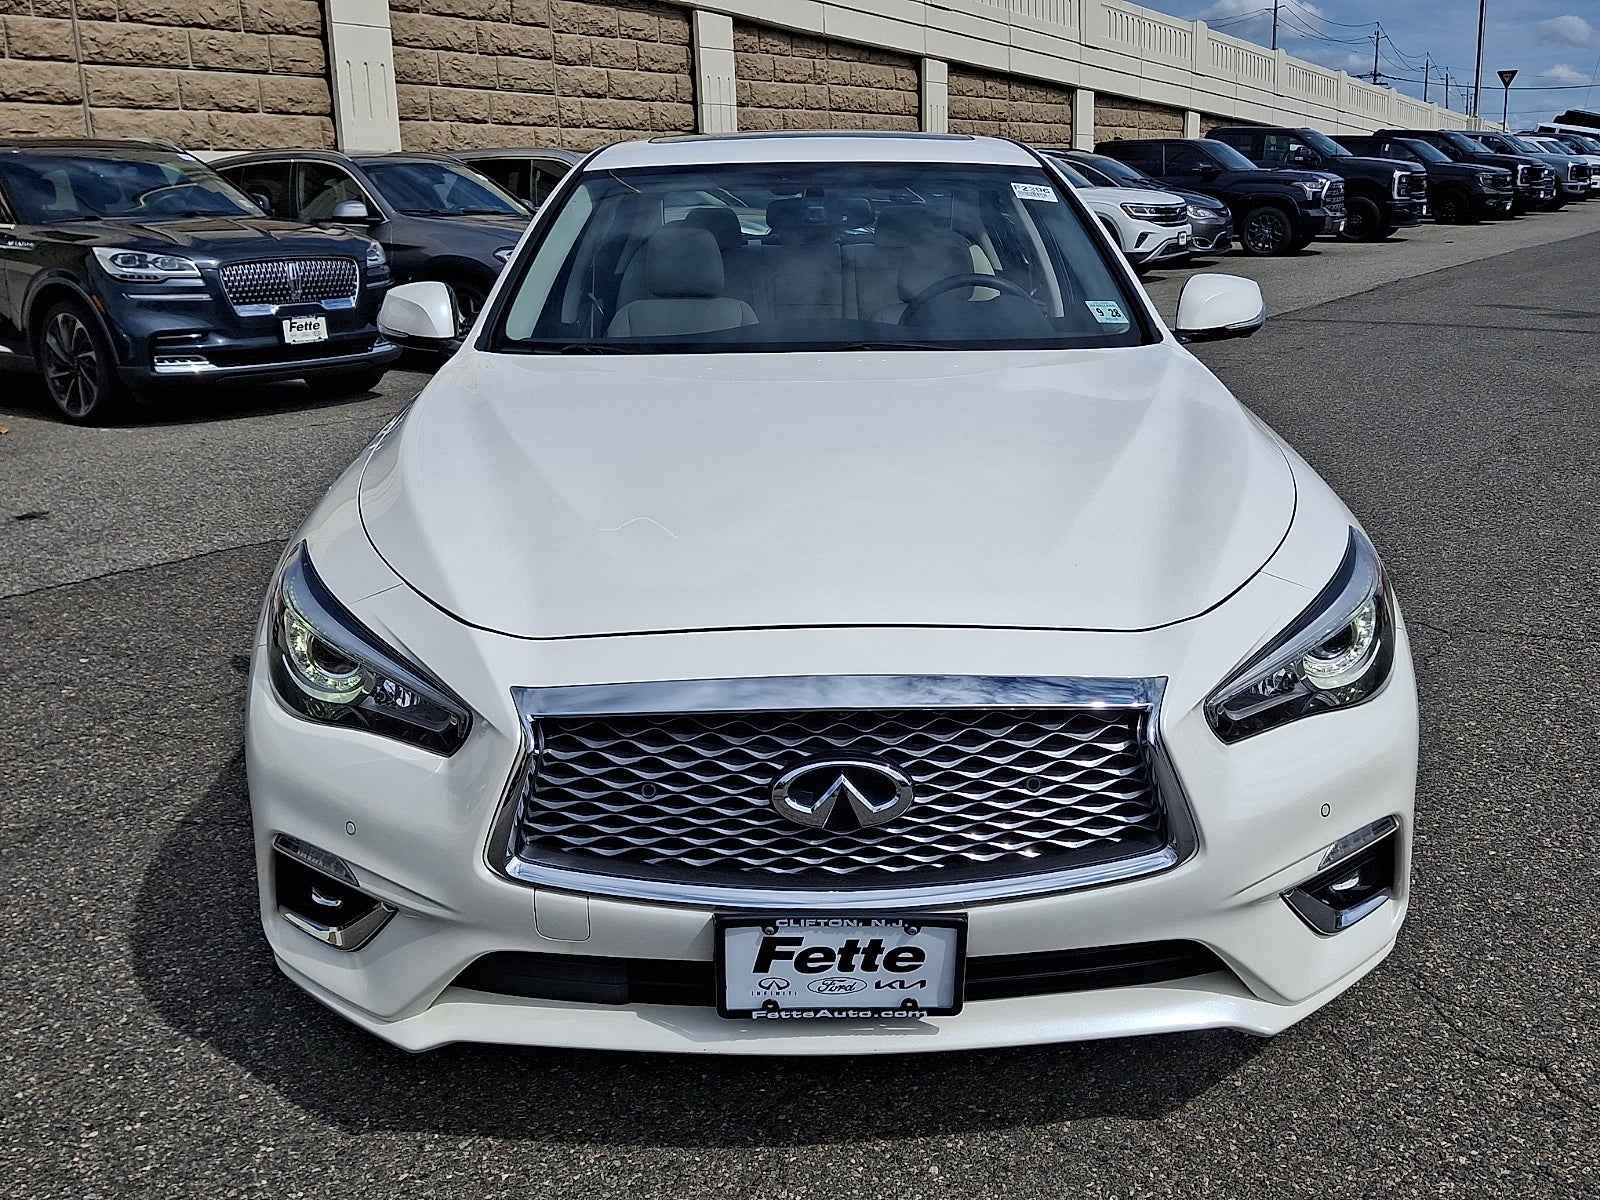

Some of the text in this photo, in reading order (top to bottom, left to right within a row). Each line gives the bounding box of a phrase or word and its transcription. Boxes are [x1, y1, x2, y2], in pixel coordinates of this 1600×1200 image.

[1095, 307, 1105, 317] 9
[289, 321, 321, 333] Fette
[775, 918, 909, 928] CLIFTON, N.J.
[751, 935, 927, 975] Fette
[817, 978, 858, 992] Ford
[751, 1008, 928, 1020] FetteAuto.com
